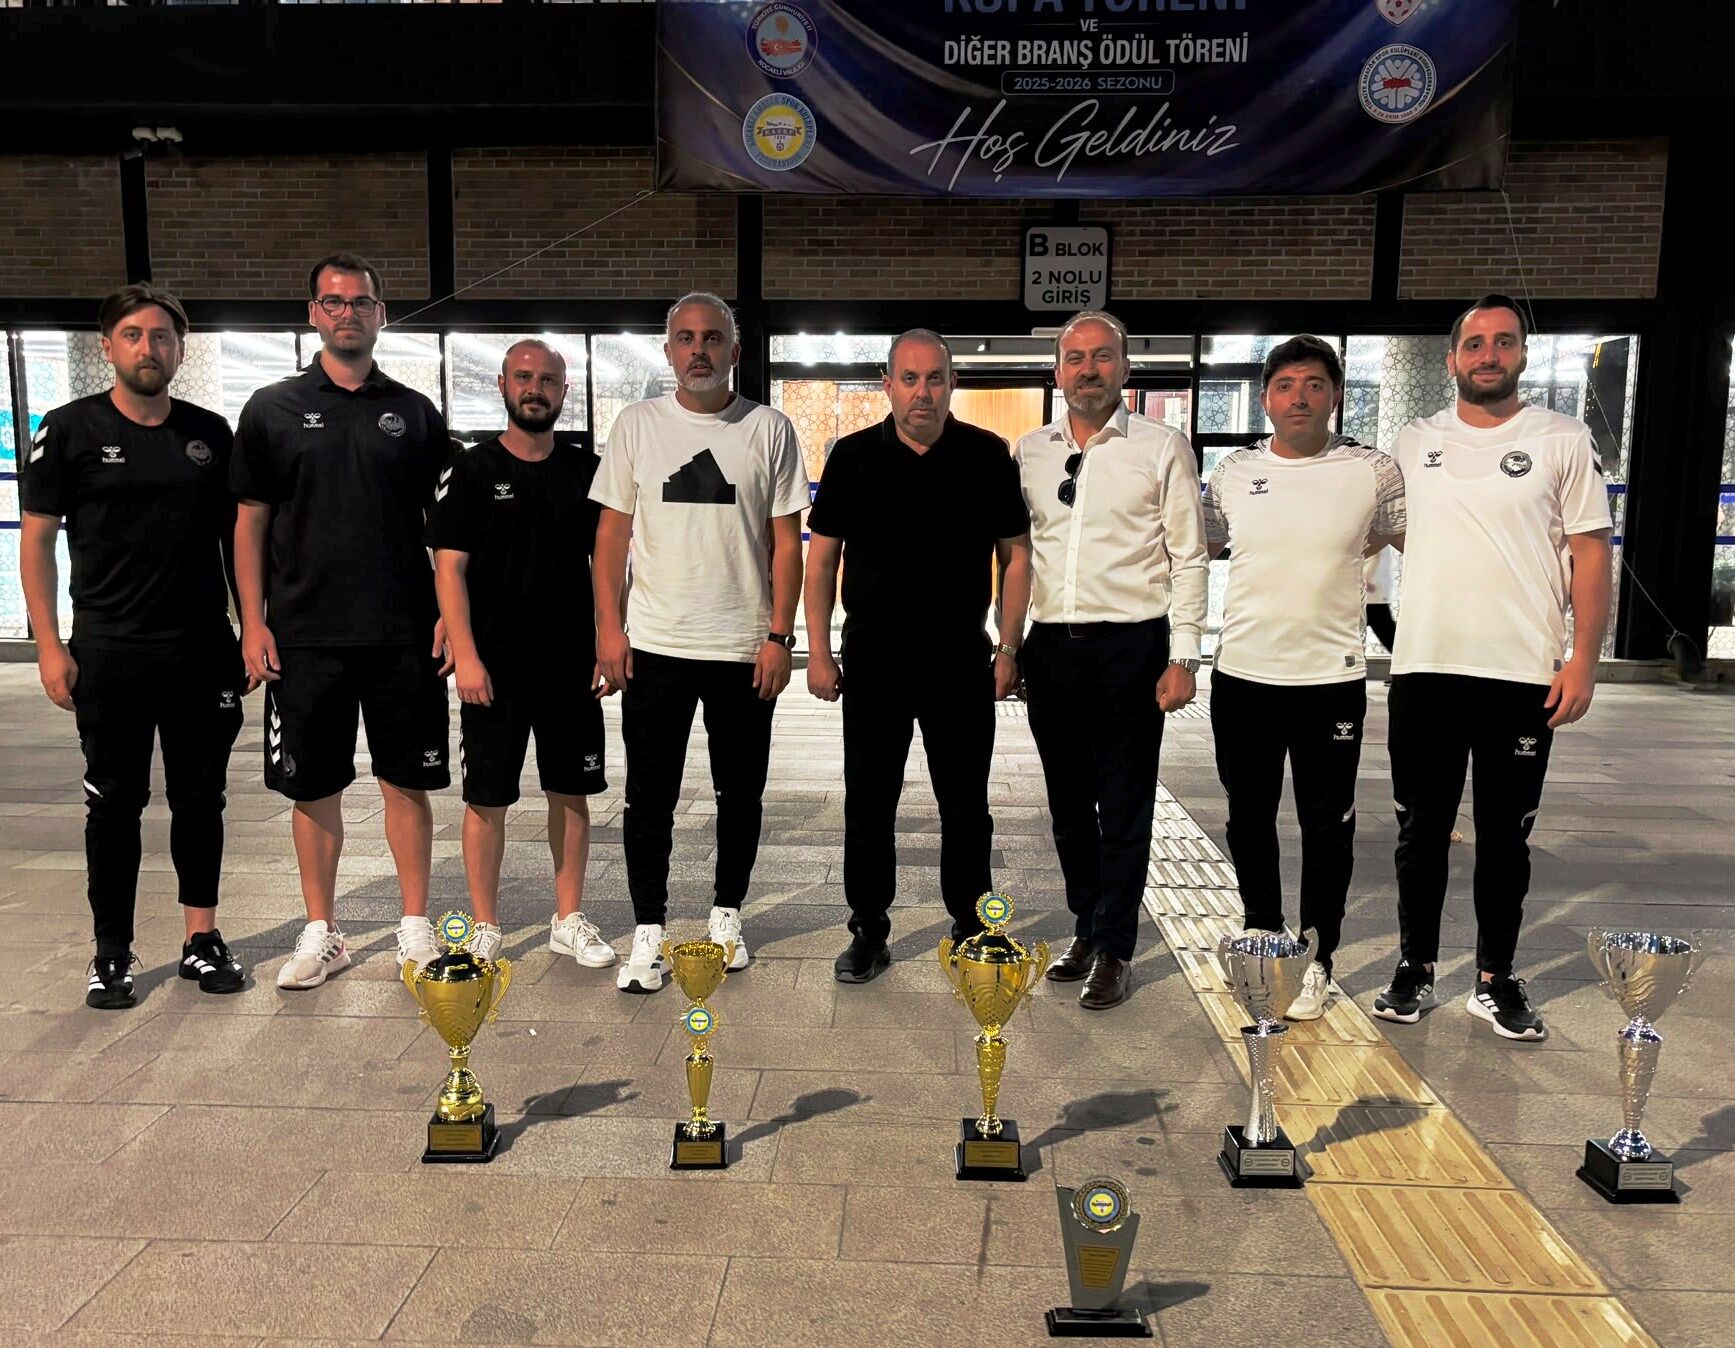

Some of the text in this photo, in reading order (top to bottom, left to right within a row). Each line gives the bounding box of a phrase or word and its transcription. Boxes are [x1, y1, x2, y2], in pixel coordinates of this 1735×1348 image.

[1080, 19, 1098, 31] VE
[944, 32, 1248, 69] DİĞER BRANŞ ÖDÜL TÖRENİ
[1014, 76, 1162, 90] 2025-2026 SEZONU
[910, 99, 1240, 191] Hoş Geldiniz
[1030, 234, 1104, 256] B BLOK
[1032, 271, 1101, 284] 2 NOLU
[1042, 286, 1091, 307] GİRİŞ
